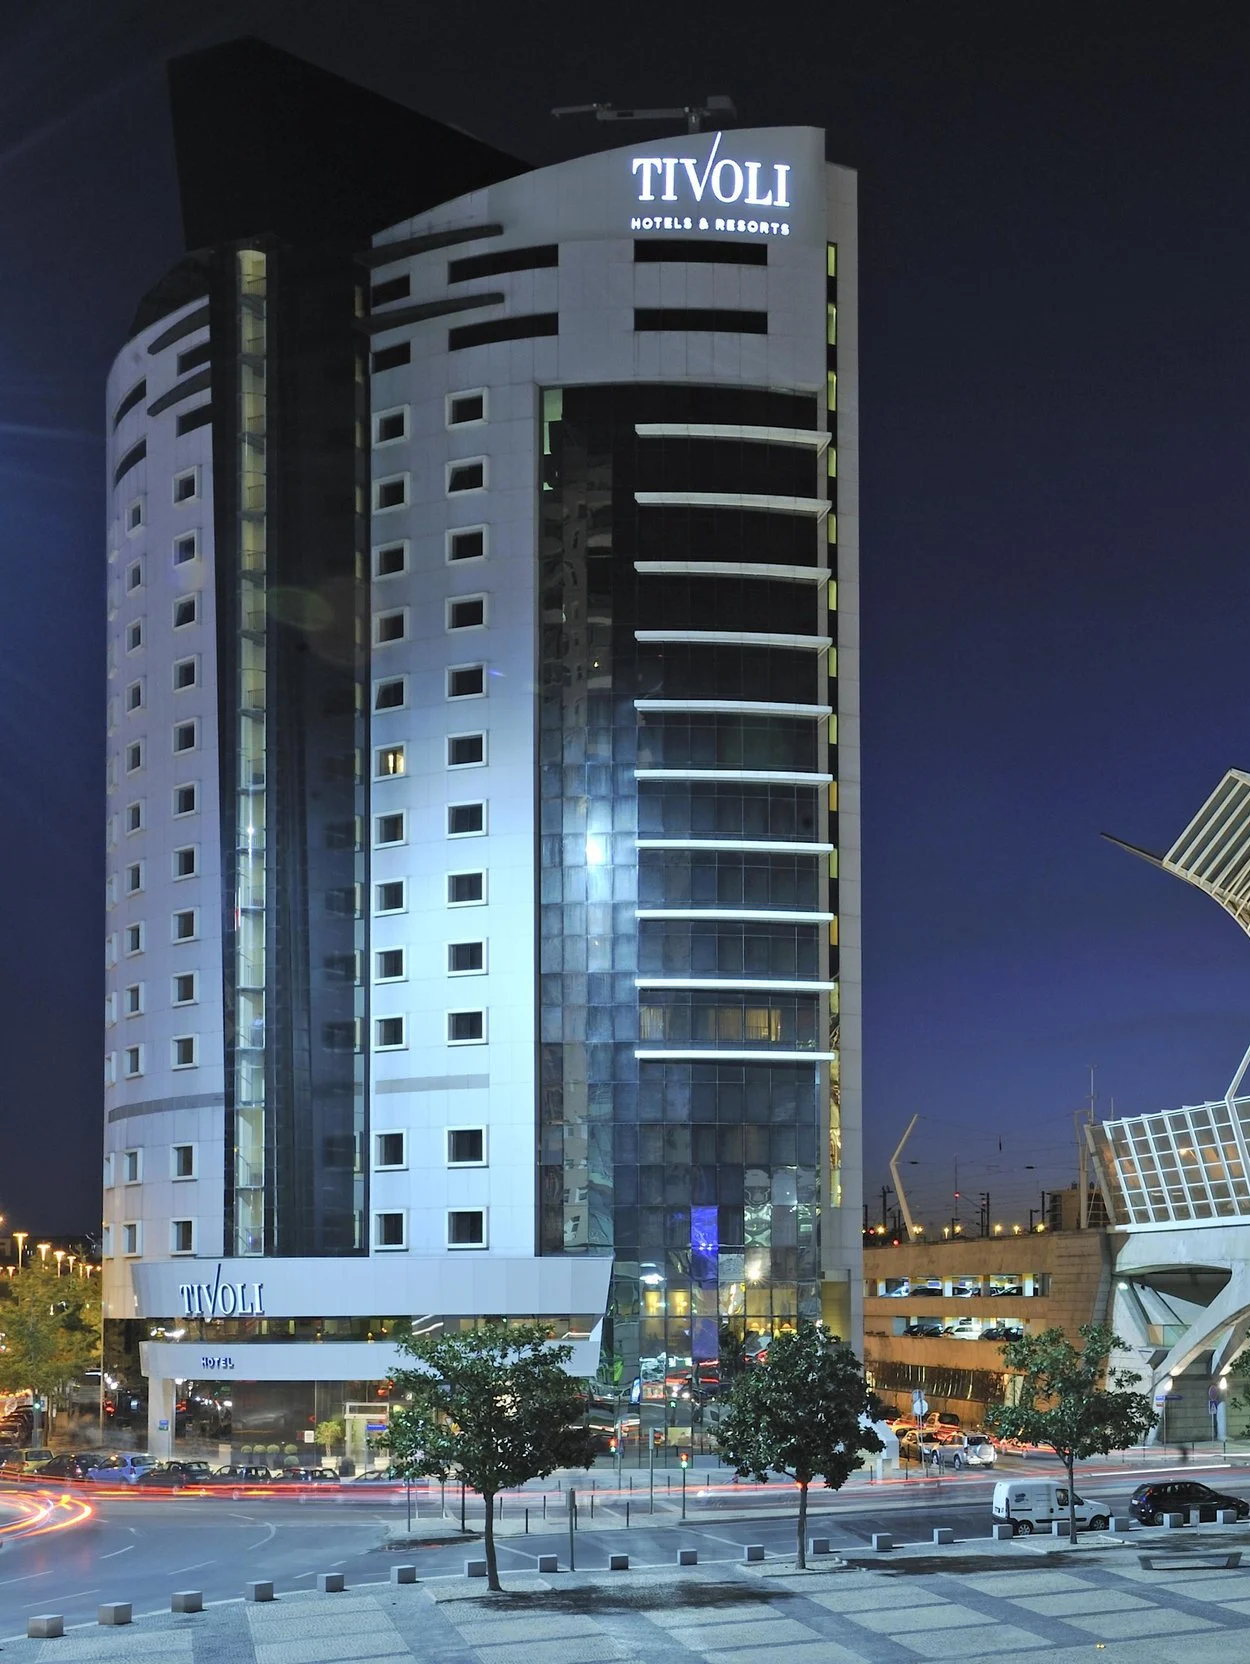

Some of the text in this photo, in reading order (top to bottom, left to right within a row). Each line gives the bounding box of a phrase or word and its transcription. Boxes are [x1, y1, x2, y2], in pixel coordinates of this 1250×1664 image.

[632, 131, 791, 207] TIVOLI
[630, 217, 790, 236] HOTELS & RESORTS
[179, 1263, 265, 1316] TIVOLI
[201, 1357, 235, 1369] HOTEL
